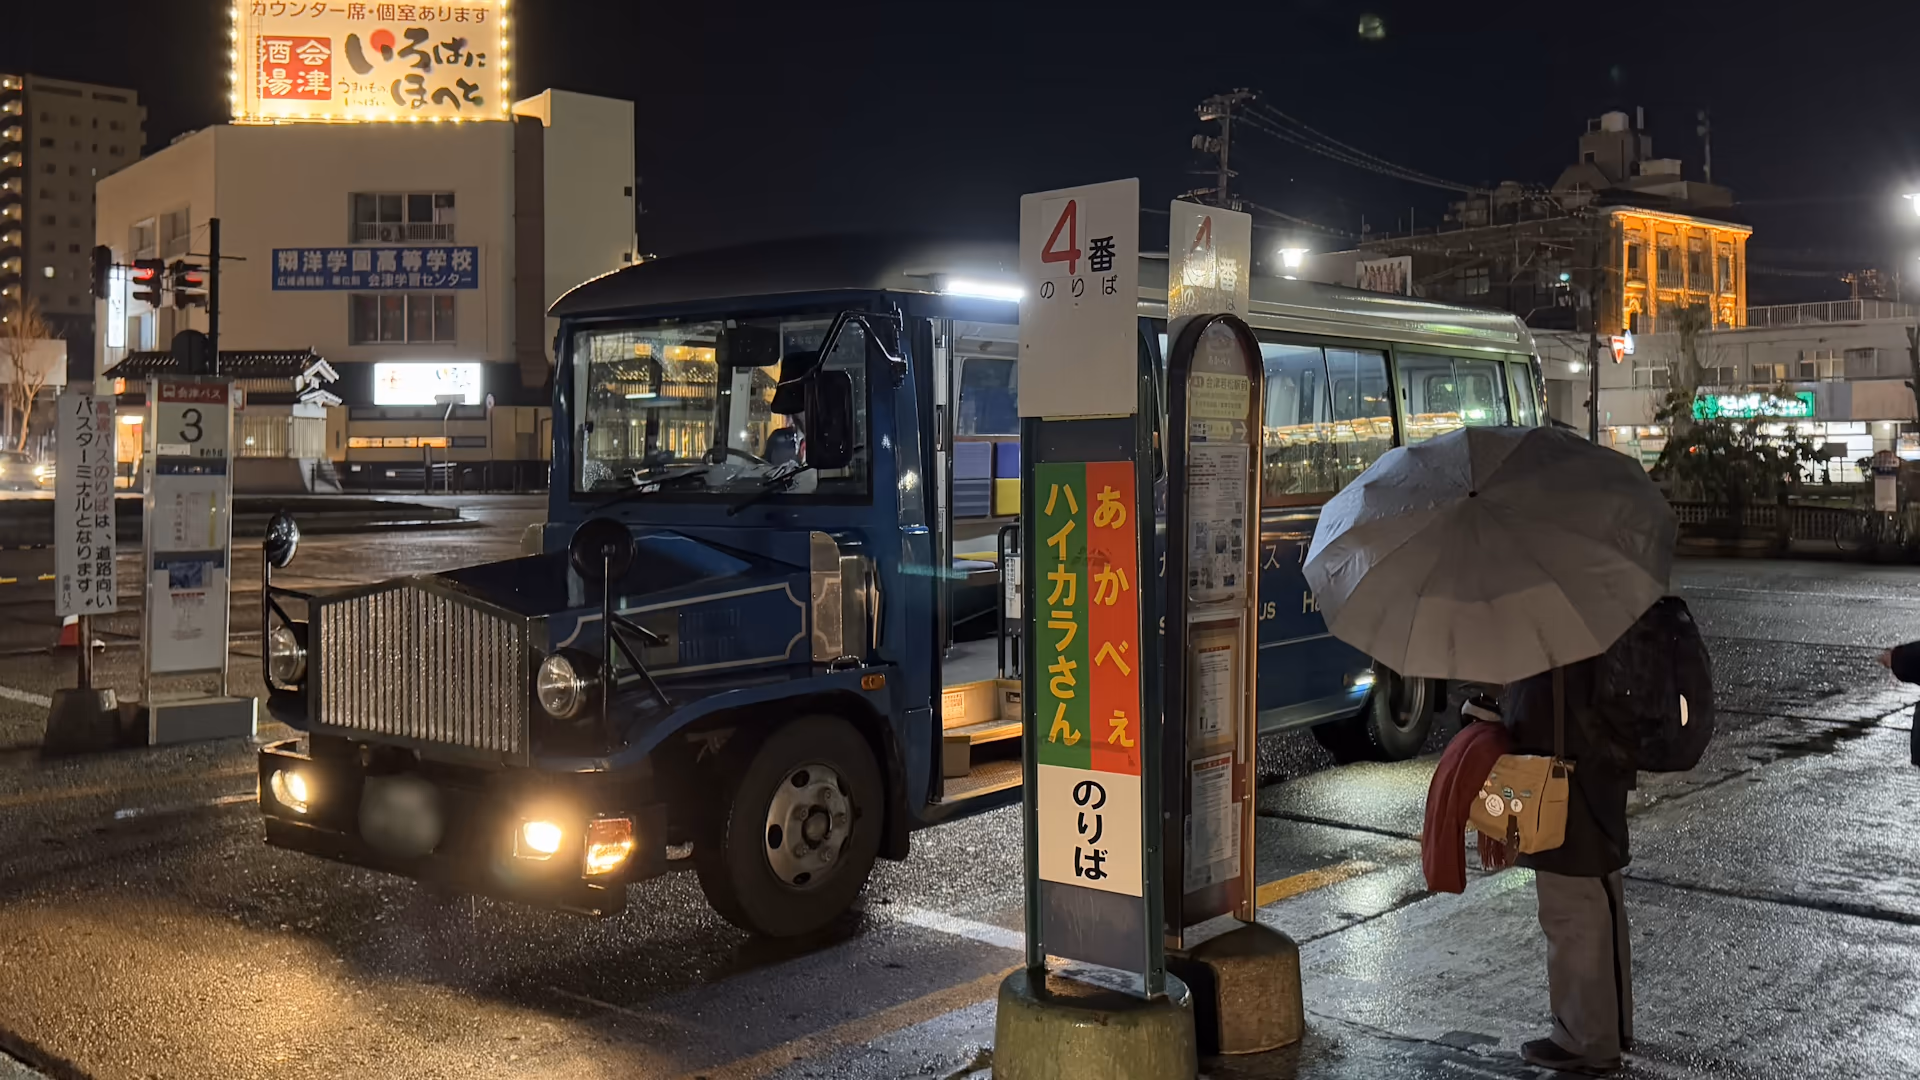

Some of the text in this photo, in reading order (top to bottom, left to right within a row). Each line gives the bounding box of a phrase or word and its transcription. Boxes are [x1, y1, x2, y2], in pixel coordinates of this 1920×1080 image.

[252, 1, 490, 23] カウンター席・個室あります
[258, 39, 293, 96] 酒場
[295, 39, 331, 96] 会津
[344, 27, 487, 75] いろはに
[390, 73, 484, 112] ほへと
[1039, 274, 1118, 299] のりば
[177, 387, 221, 399] 会津バス
[179, 408, 203, 443] 3
[1043, 483, 1082, 748] ハイカラさん
[1072, 780, 1108, 881] のりば
